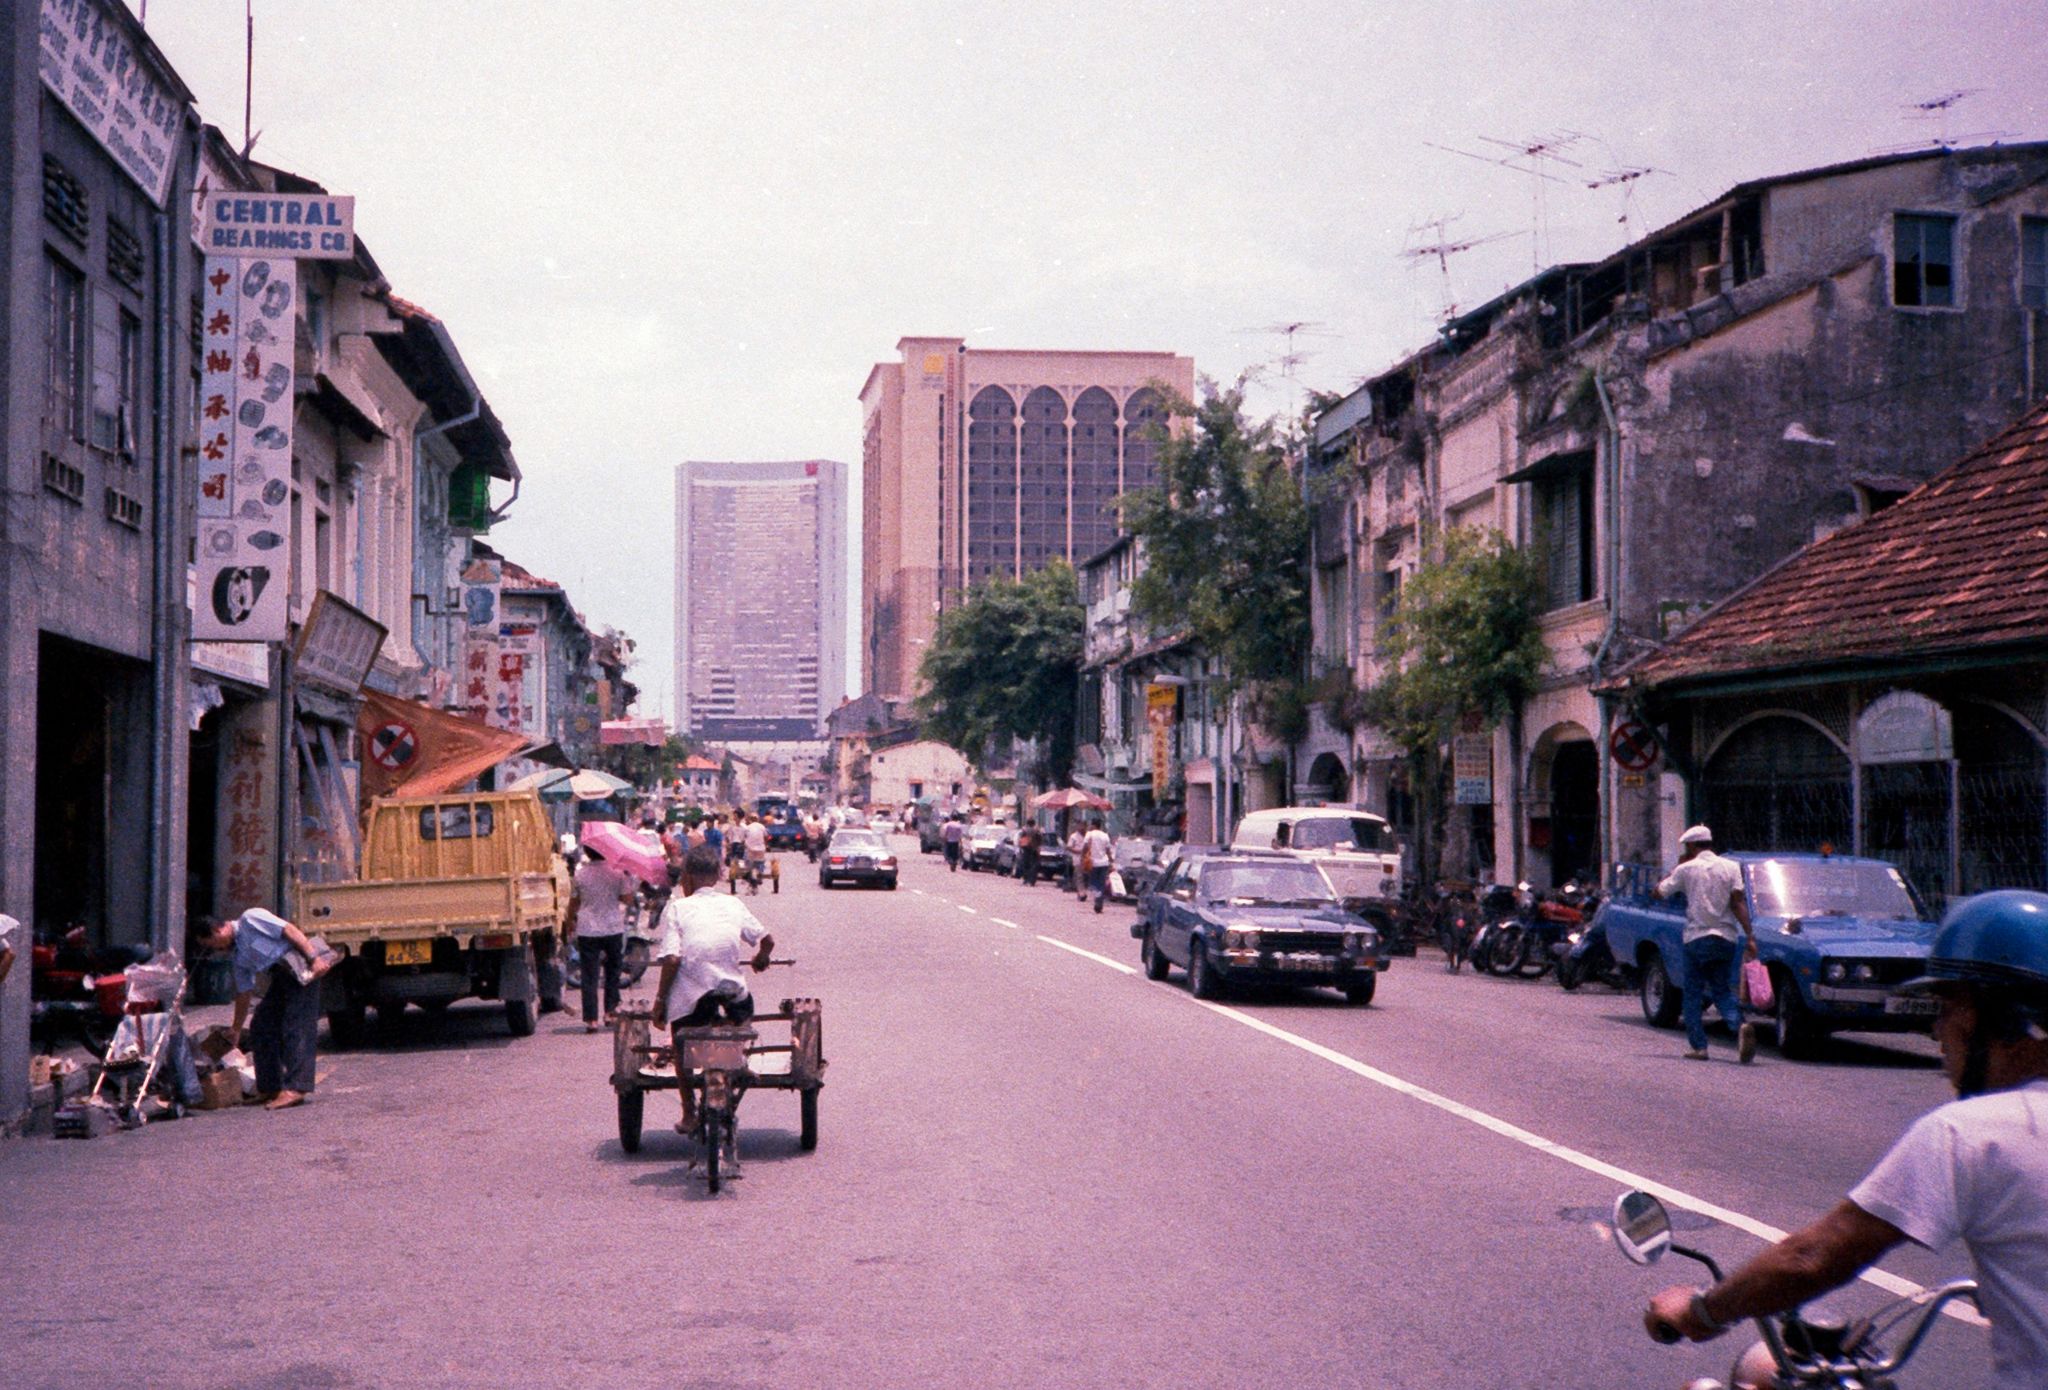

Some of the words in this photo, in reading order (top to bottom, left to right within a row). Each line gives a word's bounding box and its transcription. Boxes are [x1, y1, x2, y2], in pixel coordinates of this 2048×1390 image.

[216, 199, 342, 226] CENTRAL
[213, 228, 312, 250] BEARINGS
[203, 269, 232, 500] 中央軸承公司
